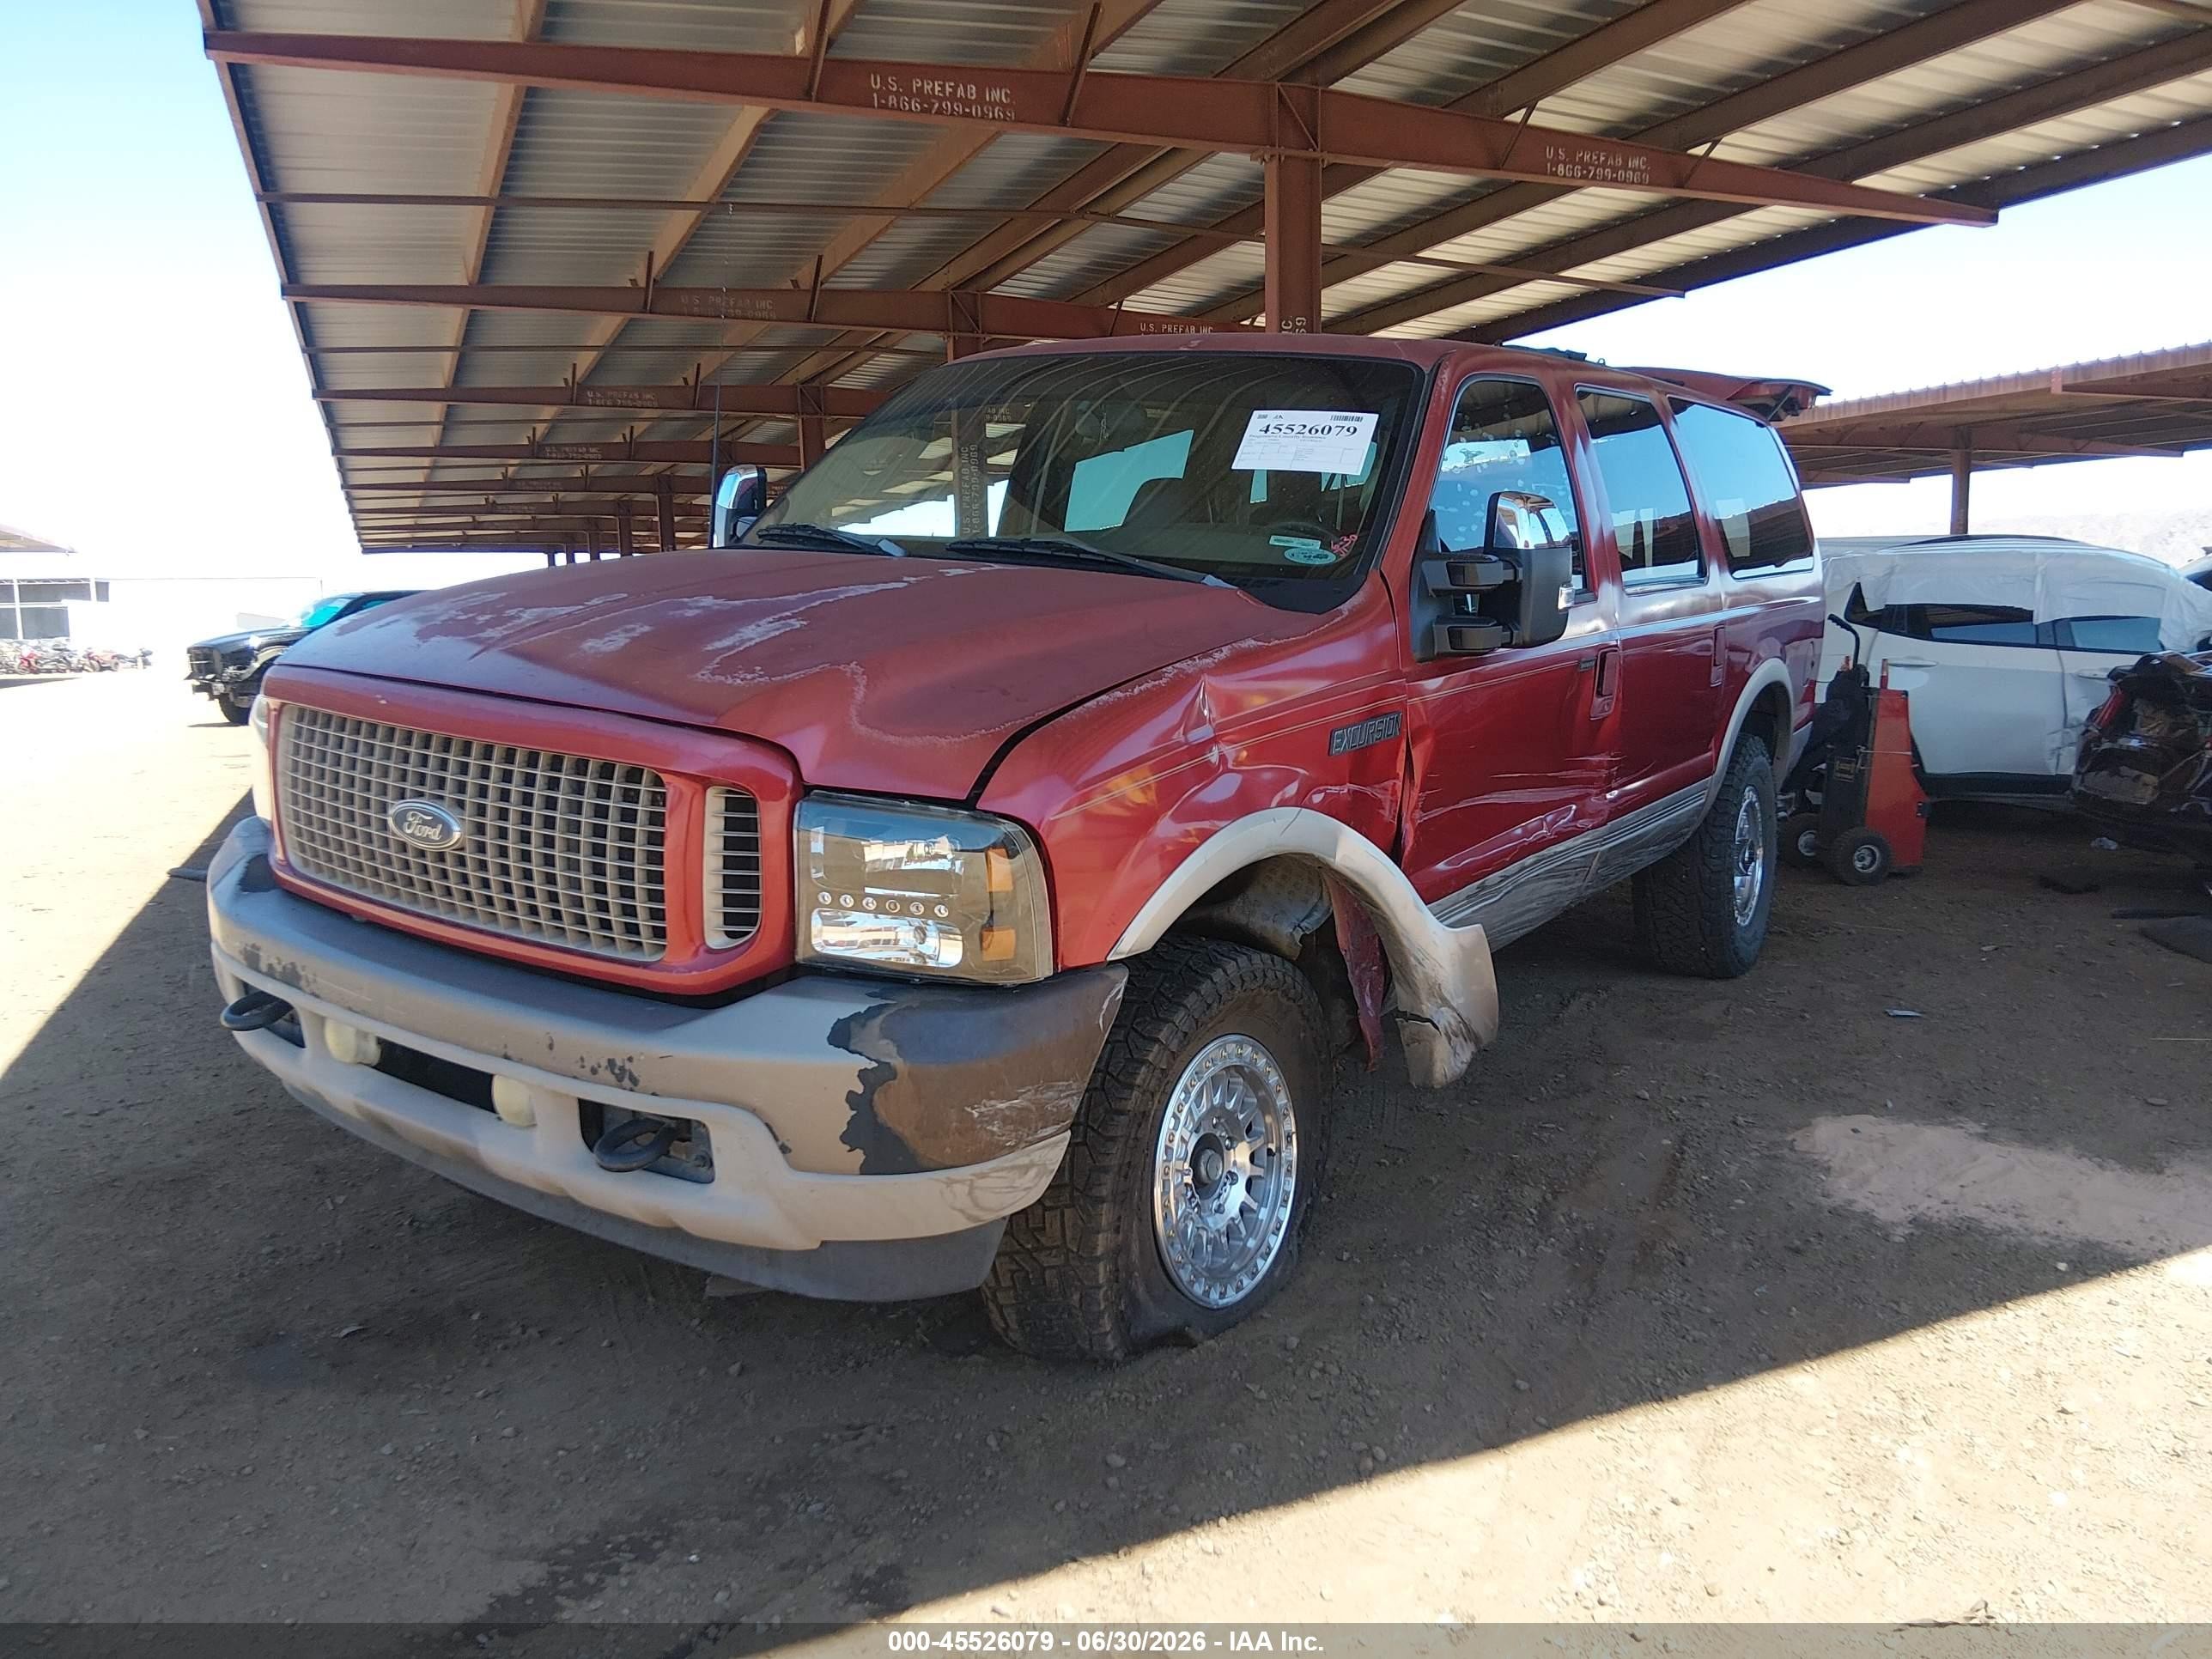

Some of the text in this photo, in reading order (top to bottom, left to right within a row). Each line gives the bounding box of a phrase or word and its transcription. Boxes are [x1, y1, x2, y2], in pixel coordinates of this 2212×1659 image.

[871, 73, 902, 93] U.S.
[913, 77, 976, 100] PREFAB
[872, 92, 1016, 121] 1-866-799-0969
[1576, 150, 1622, 166] PREFAB
[1628, 155, 1650, 171] INC.
[1547, 162, 1650, 185] 1-866-799-0969
[1140, 323, 1158, 332] U.S.
[1162, 323, 1195, 334] PREFAB
[1259, 423, 1358, 437] 45526079
[1332, 714, 1402, 754] EXCURSION
[403, 811, 442, 841] Ford
